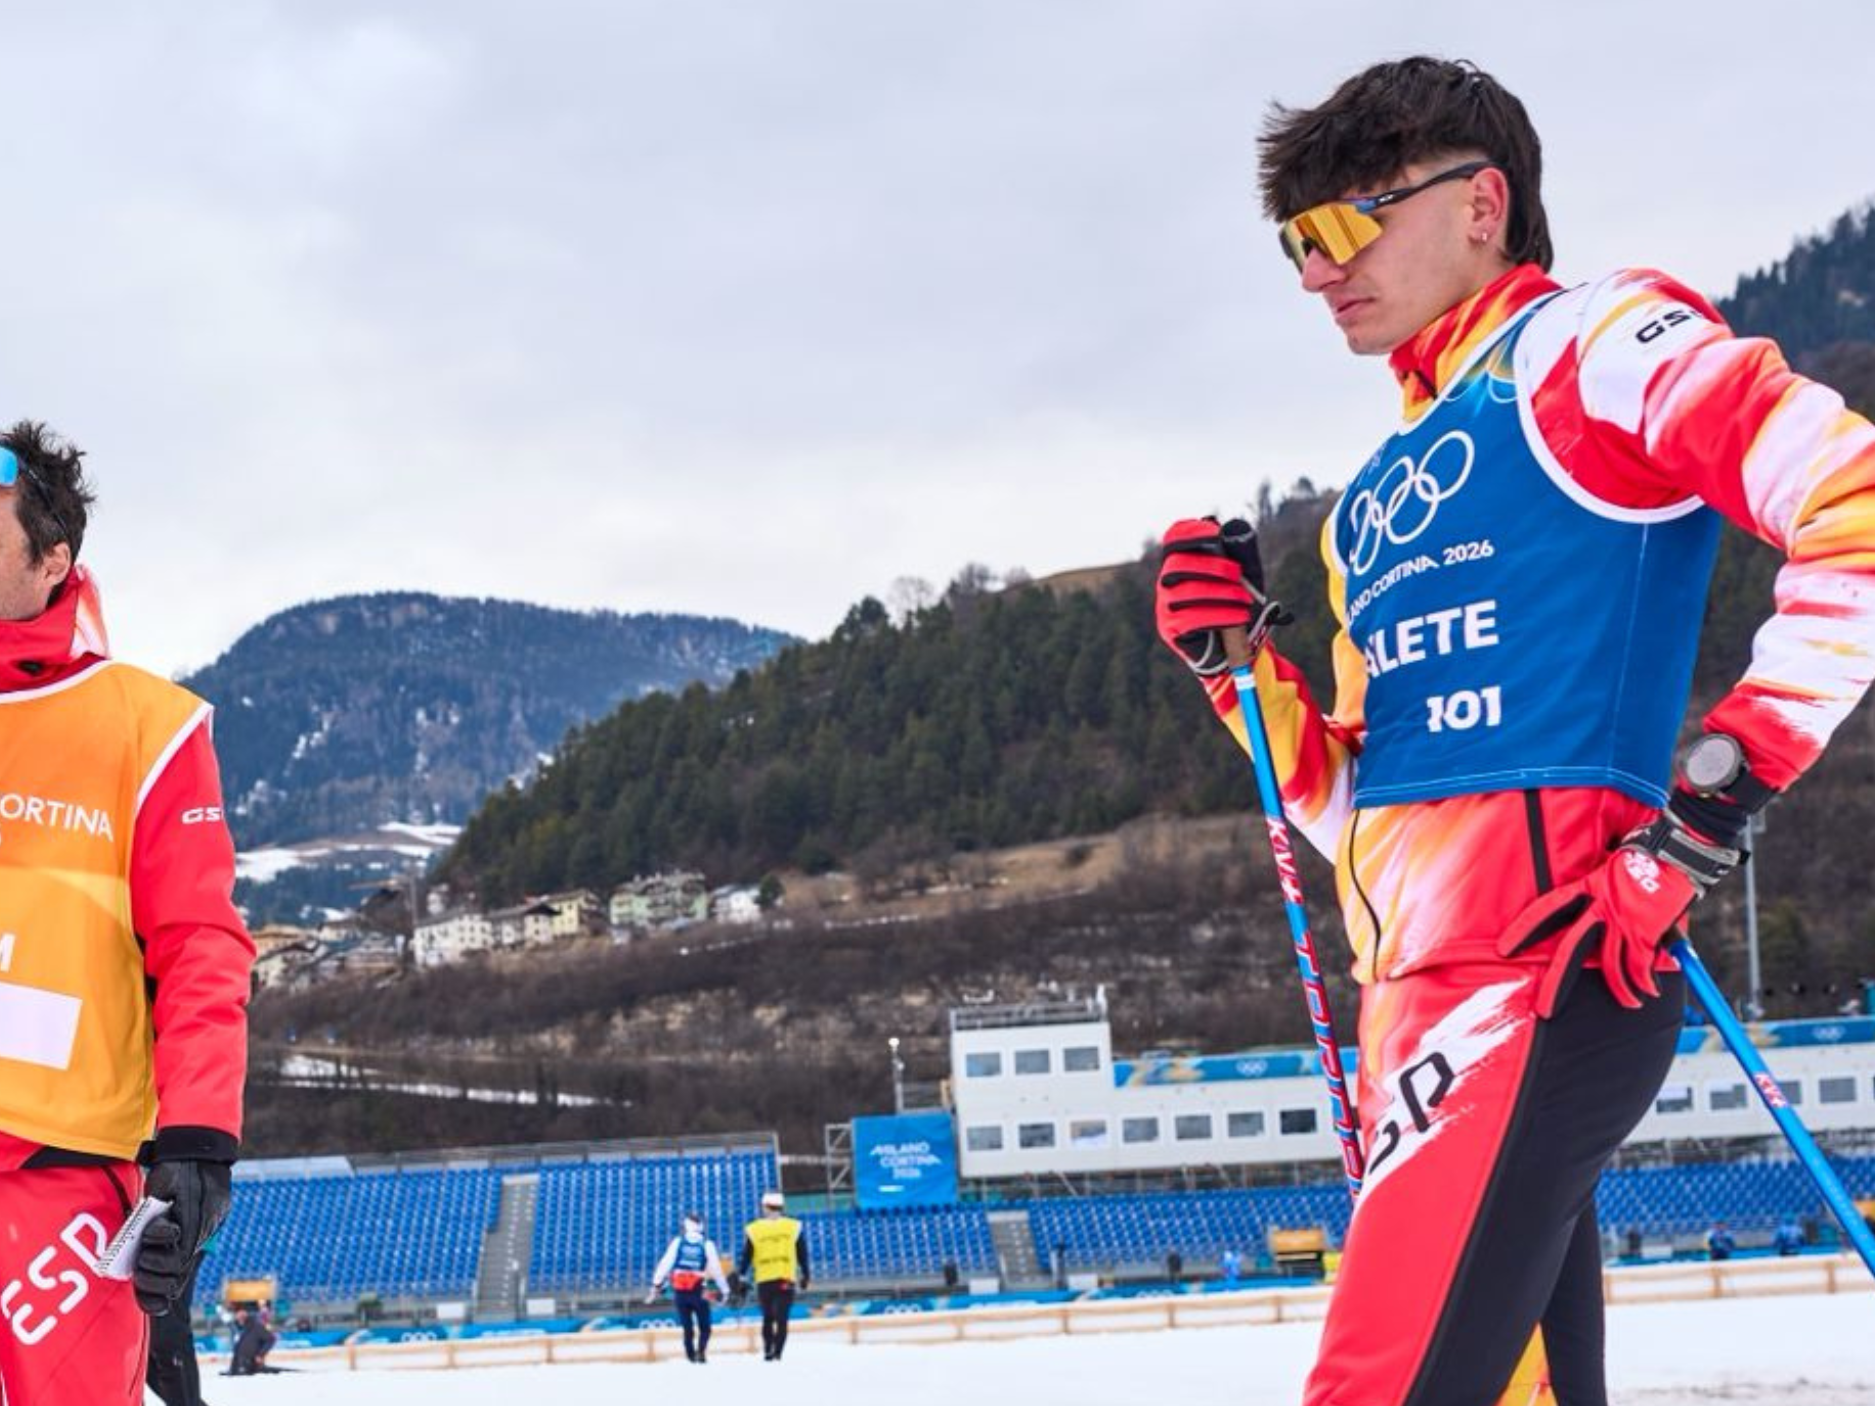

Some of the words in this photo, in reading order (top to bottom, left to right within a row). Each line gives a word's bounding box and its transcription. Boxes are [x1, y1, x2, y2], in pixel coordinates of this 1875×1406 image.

[1636, 310, 1702, 343] GS
[1443, 540, 1495, 565] 2026
[1426, 686, 1502, 732] 101
[182, 807, 225, 825] GS
